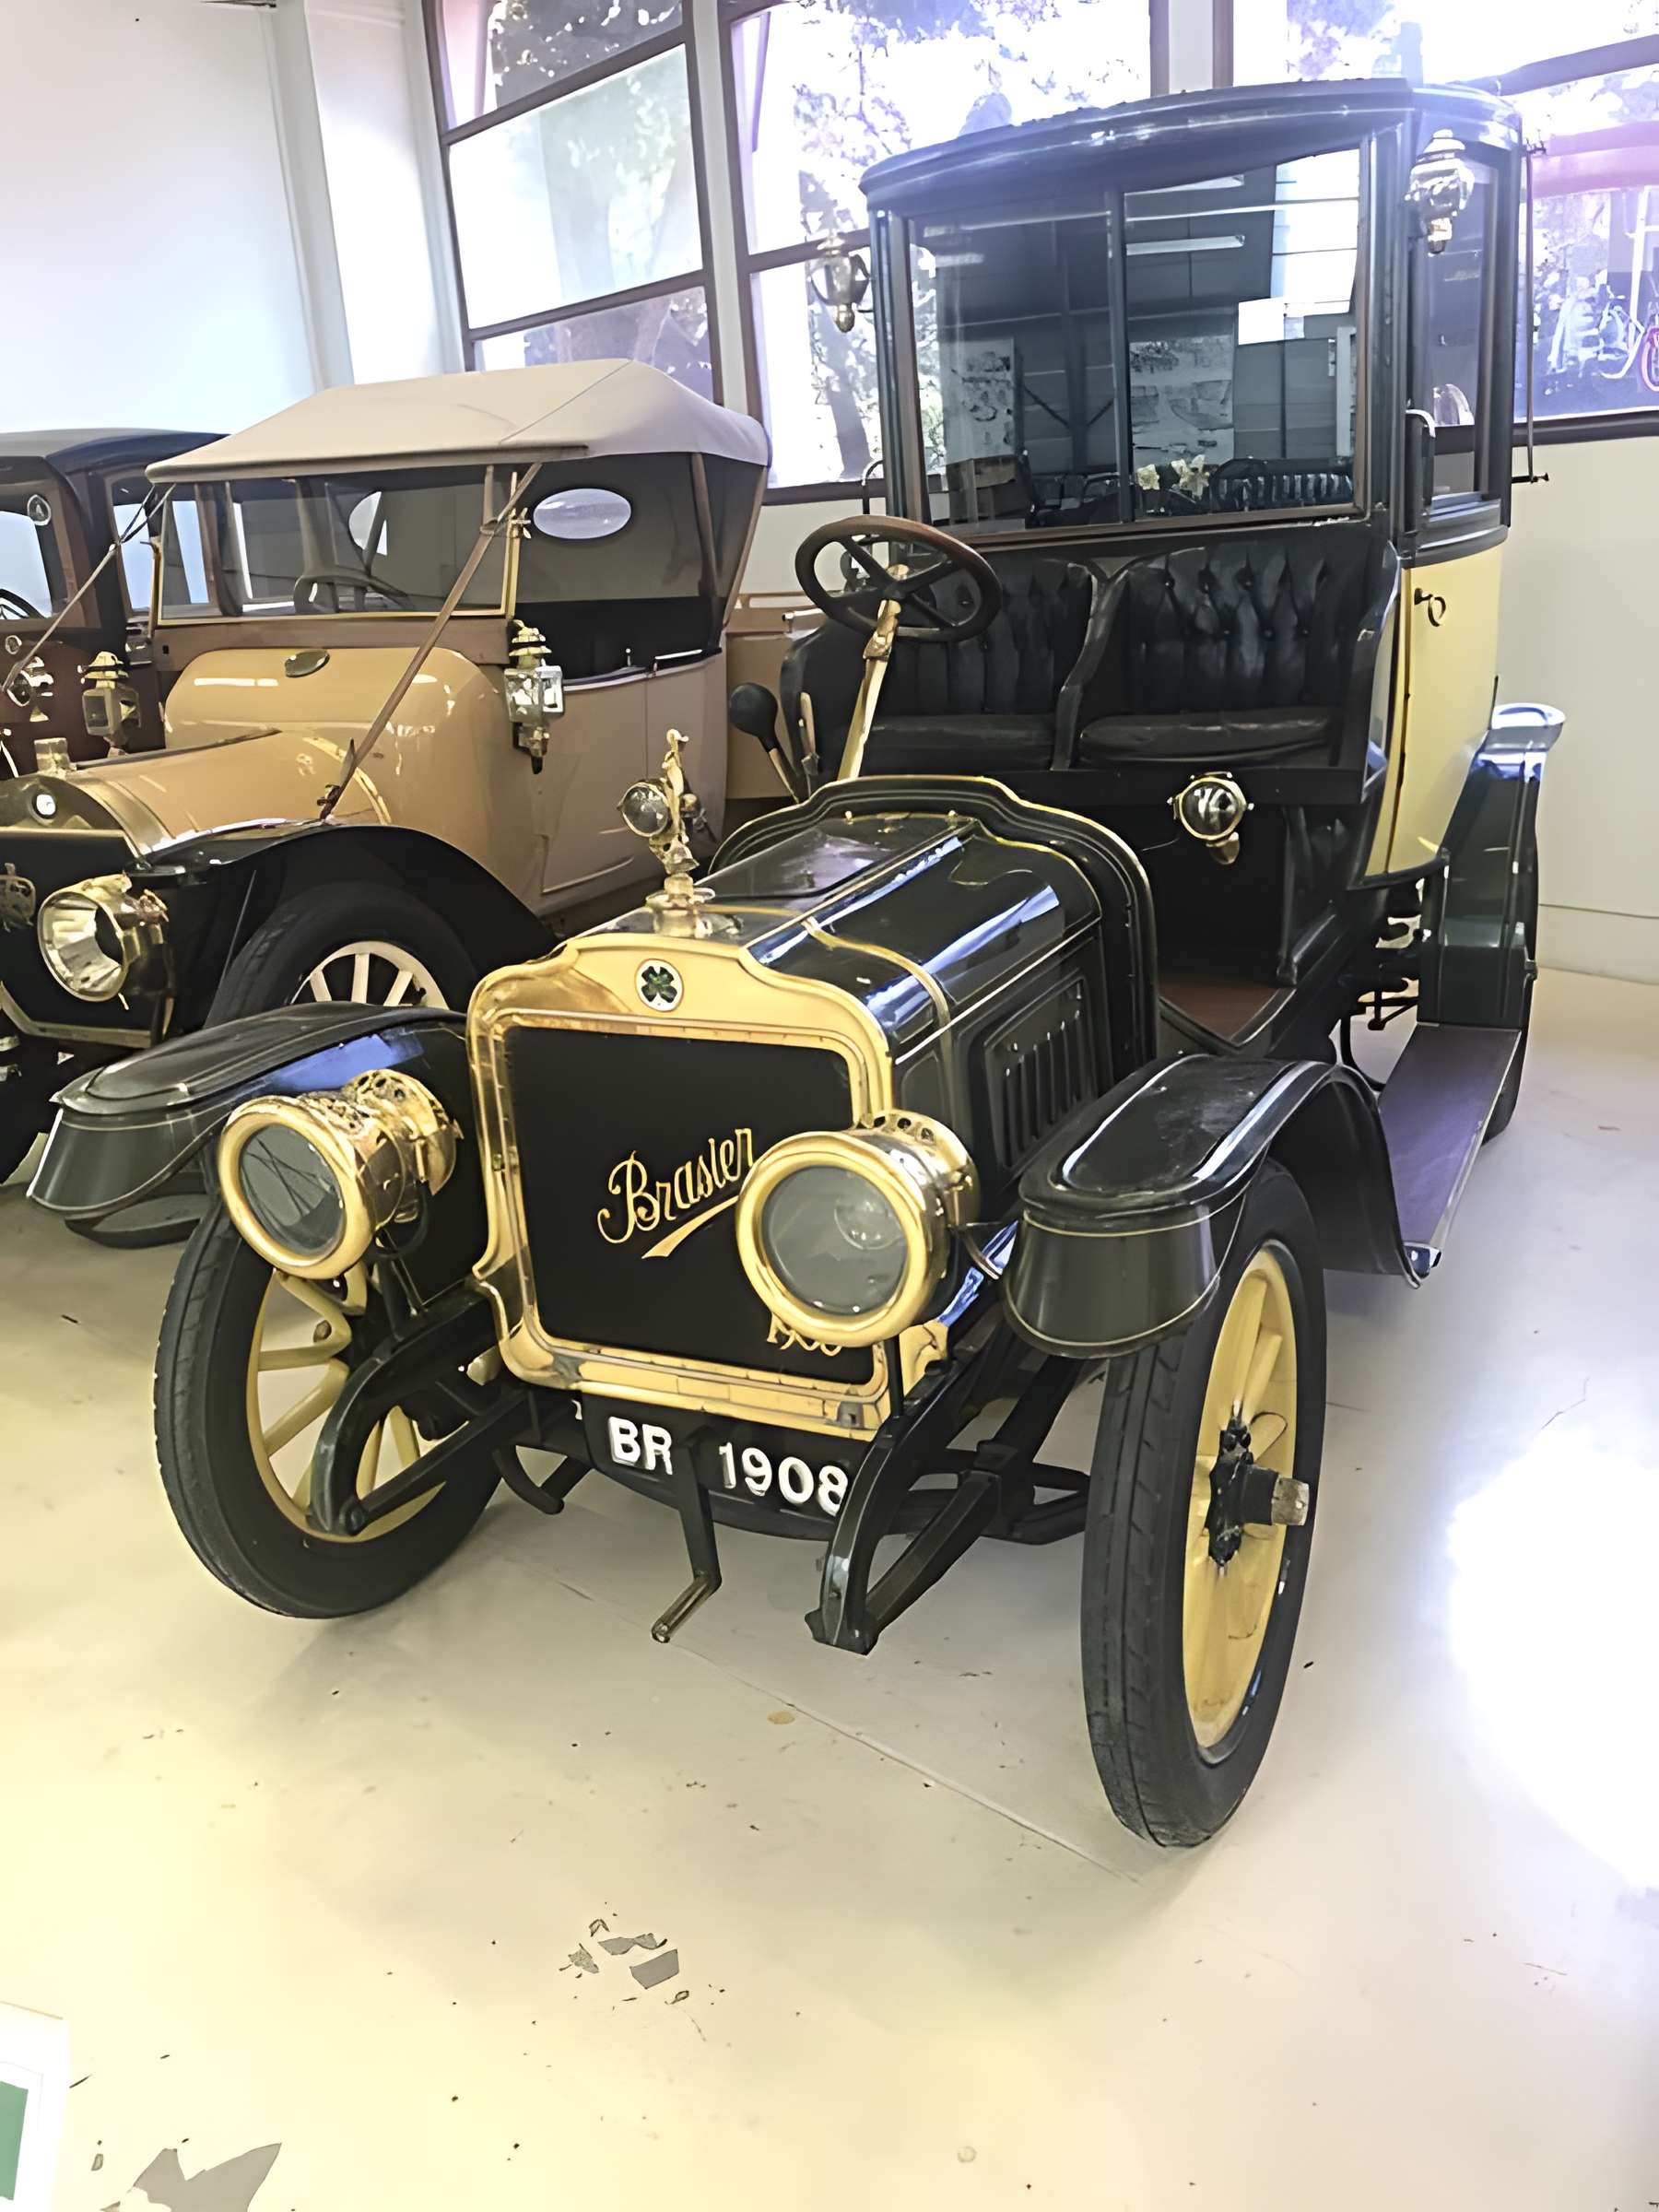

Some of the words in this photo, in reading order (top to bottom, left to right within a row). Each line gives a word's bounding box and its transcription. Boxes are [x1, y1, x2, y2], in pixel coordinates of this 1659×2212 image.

[597, 1126, 755, 1244] Brasier
[607, 1416, 674, 1476] BR
[718, 1441, 849, 1517] 1908
